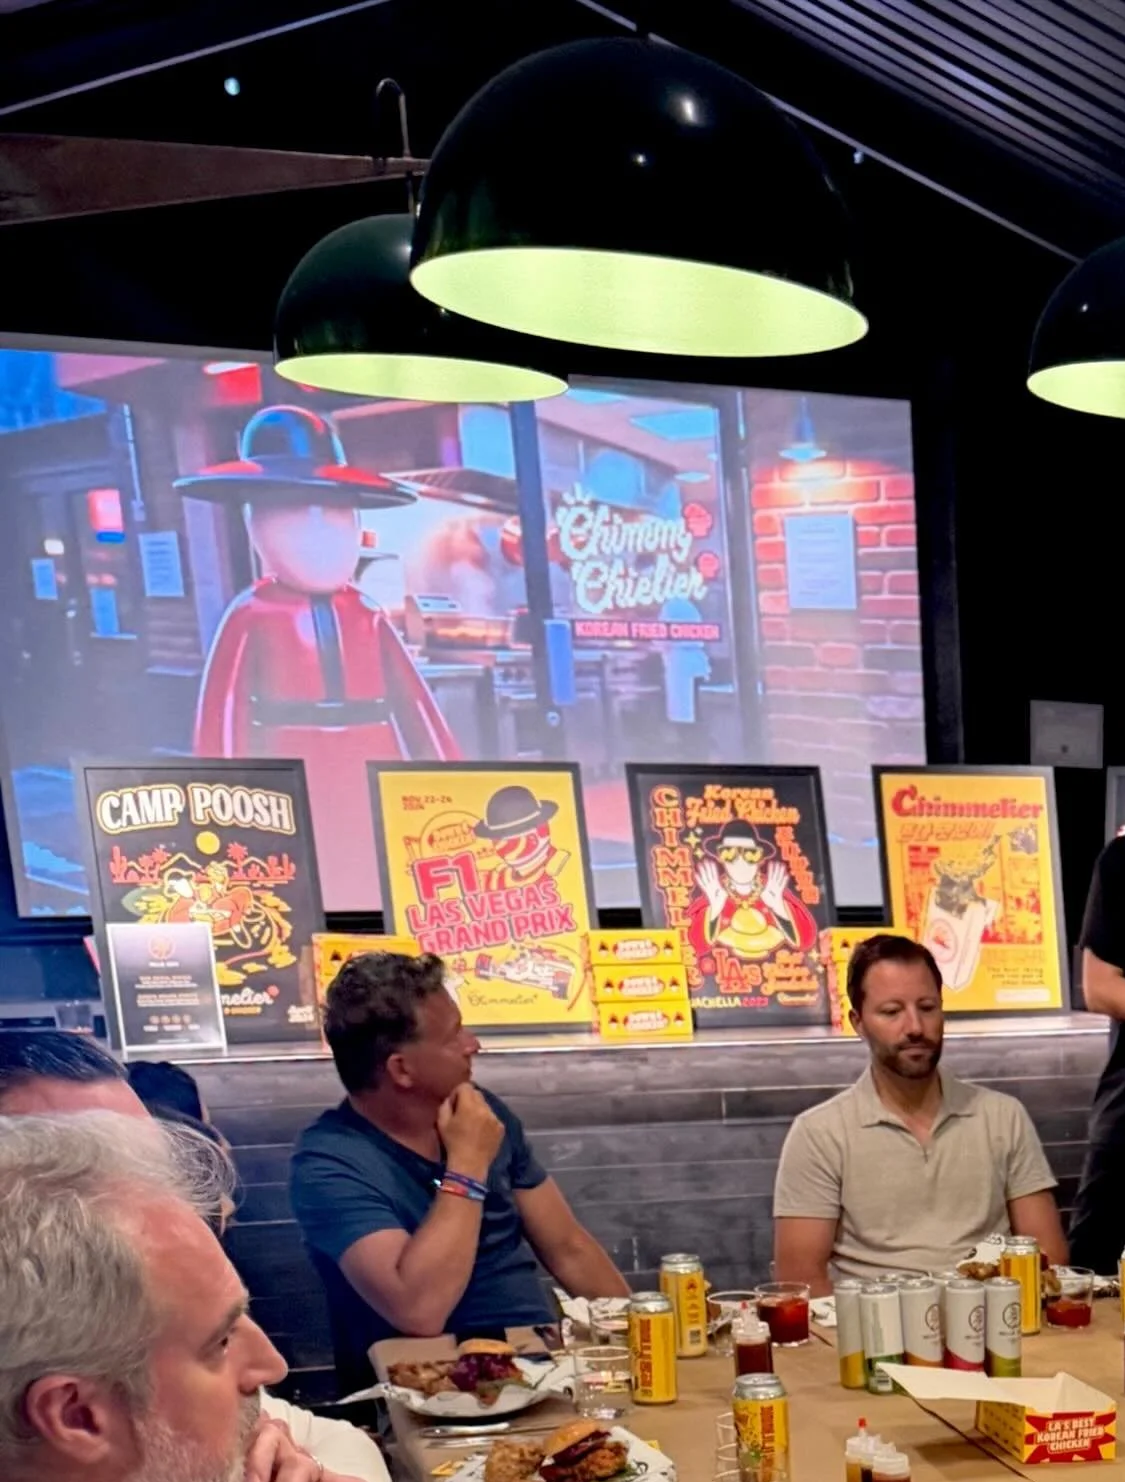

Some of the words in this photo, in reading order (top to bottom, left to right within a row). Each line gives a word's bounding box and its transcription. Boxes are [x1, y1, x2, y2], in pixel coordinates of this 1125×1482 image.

[575, 621, 629, 637] KOREAN
[631, 622, 668, 638] FRIED
[669, 624, 719, 639] CHICKEN
[97, 785, 185, 833] CAMP
[189, 784, 295, 834] POOSH
[892, 785, 1043, 818] Chimmelier
[414, 851, 480, 903] F1
[406, 897, 465, 932] LAS
[464, 880, 561, 922] VEGAS
[417, 917, 511, 957] GRAND
[512, 904, 577, 942] PRIX
[1037, 1430, 1076, 1443] KOREAN
[1078, 1425, 1104, 1439] FRIED
[1048, 1421, 1071, 1432] LA'S
[1072, 1418, 1095, 1430] BEST
[1050, 1439, 1090, 1451] CHICKEN
